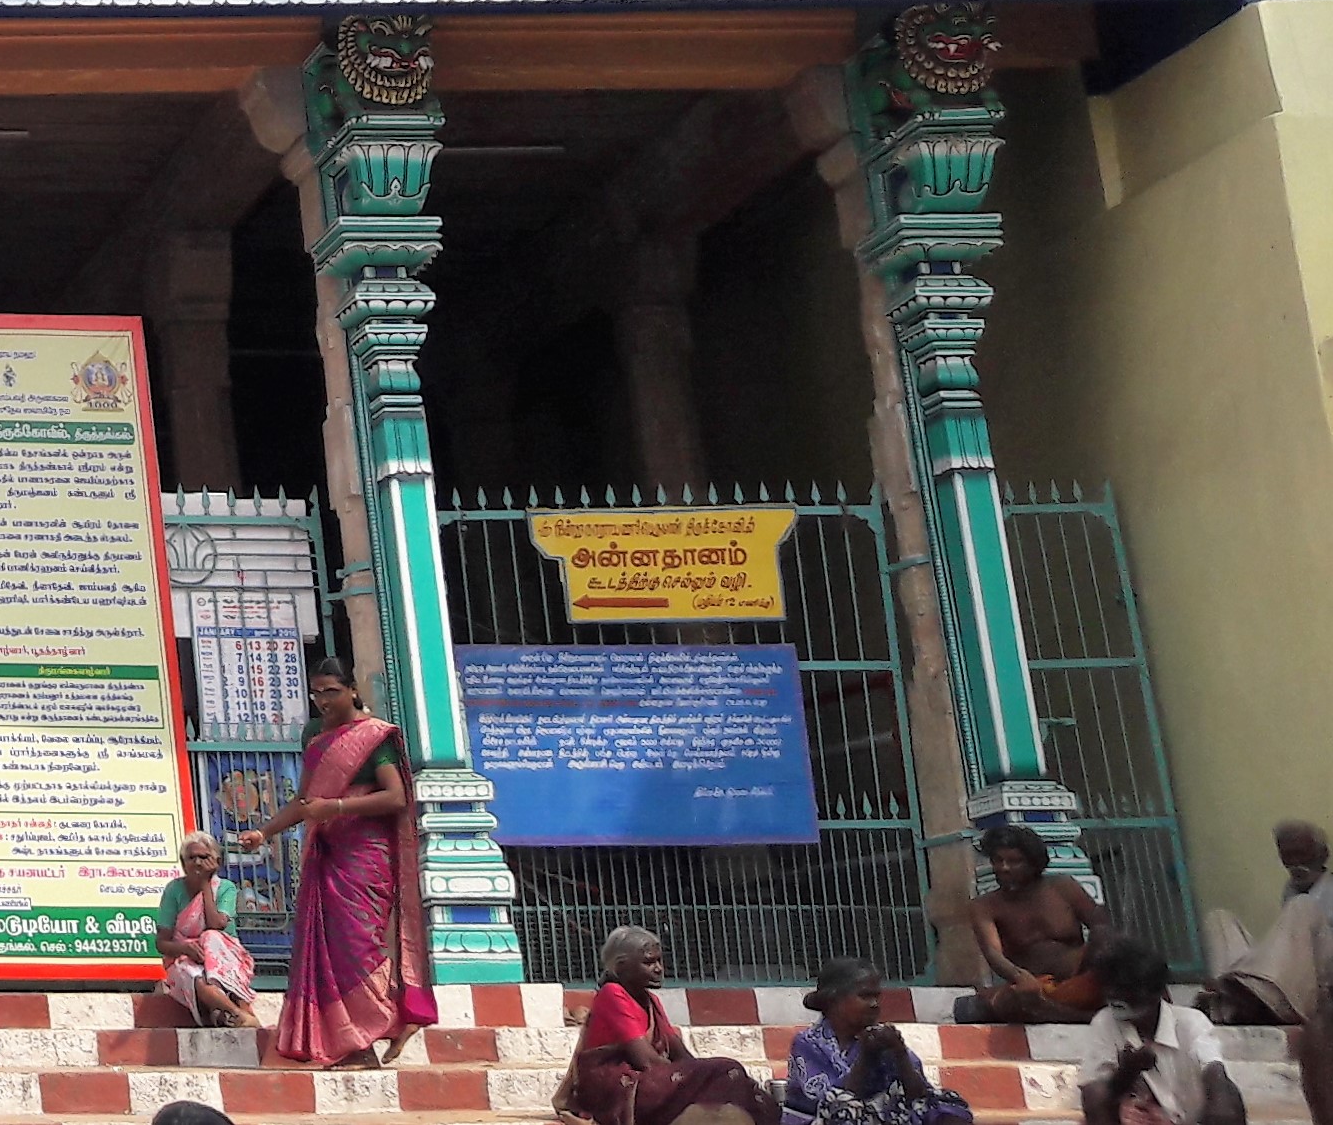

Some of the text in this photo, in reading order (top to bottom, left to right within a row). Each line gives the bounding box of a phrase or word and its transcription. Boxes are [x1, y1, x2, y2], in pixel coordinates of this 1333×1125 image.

[571, 540, 747, 572] அன்னதானம்
[235, 641, 242, 651] 6
[248, 641, 261, 651] 13
[283, 641, 295, 651] 27
[237, 653, 242, 662] 7
[250, 653, 262, 663] 14
[284, 653, 296, 663] 28
[237, 665, 244, 674] 8
[251, 665, 263, 674] 15
[285, 665, 298, 675] 29
[238, 677, 245, 686] 9
[251, 677, 264, 686] 16
[286, 677, 299, 687] 30
[235, 689, 248, 698] 10
[252, 689, 265, 698] 17
[287, 689, 299, 699] 31
[236, 701, 248, 710] 11
[254, 701, 266, 710] 18
[238, 713, 250, 722] 12
[254, 713, 266, 723] 19
[85, 915, 100, 934] &
[40, 940, 67, 952] செல்
